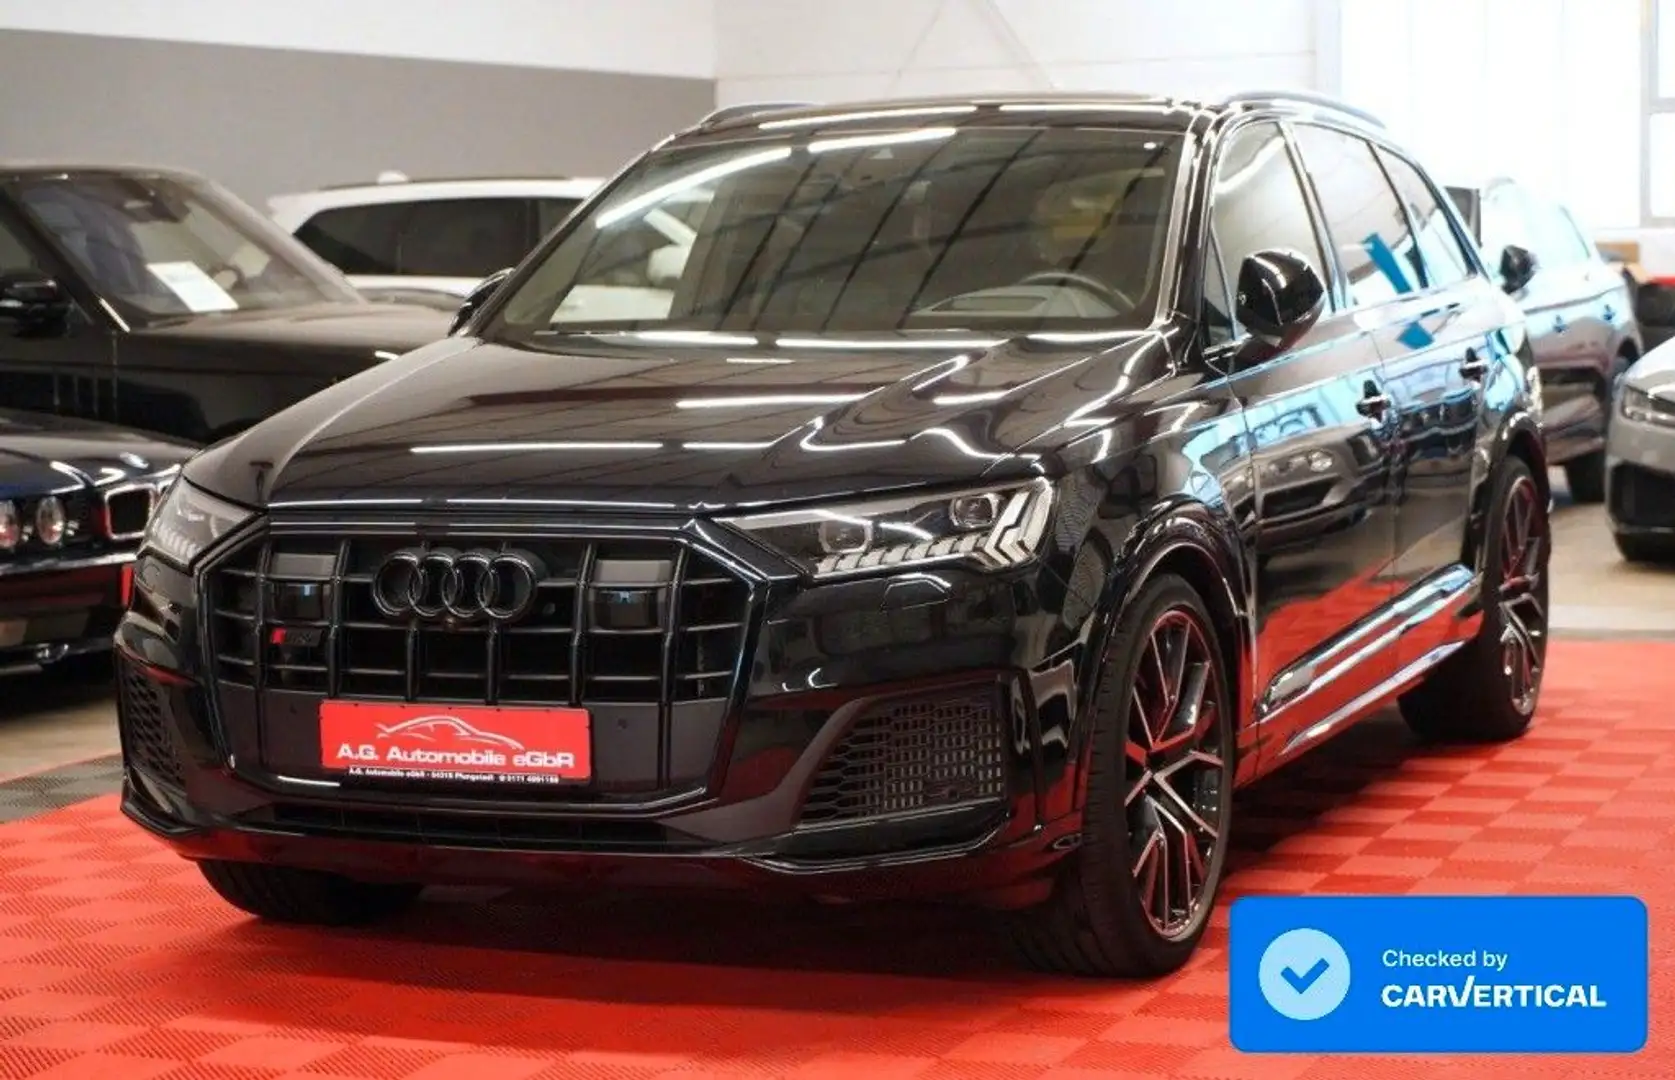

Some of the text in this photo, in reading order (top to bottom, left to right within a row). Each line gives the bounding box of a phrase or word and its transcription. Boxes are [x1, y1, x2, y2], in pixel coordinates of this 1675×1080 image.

[337, 743, 574, 769] A.G. Automobile eGbR
